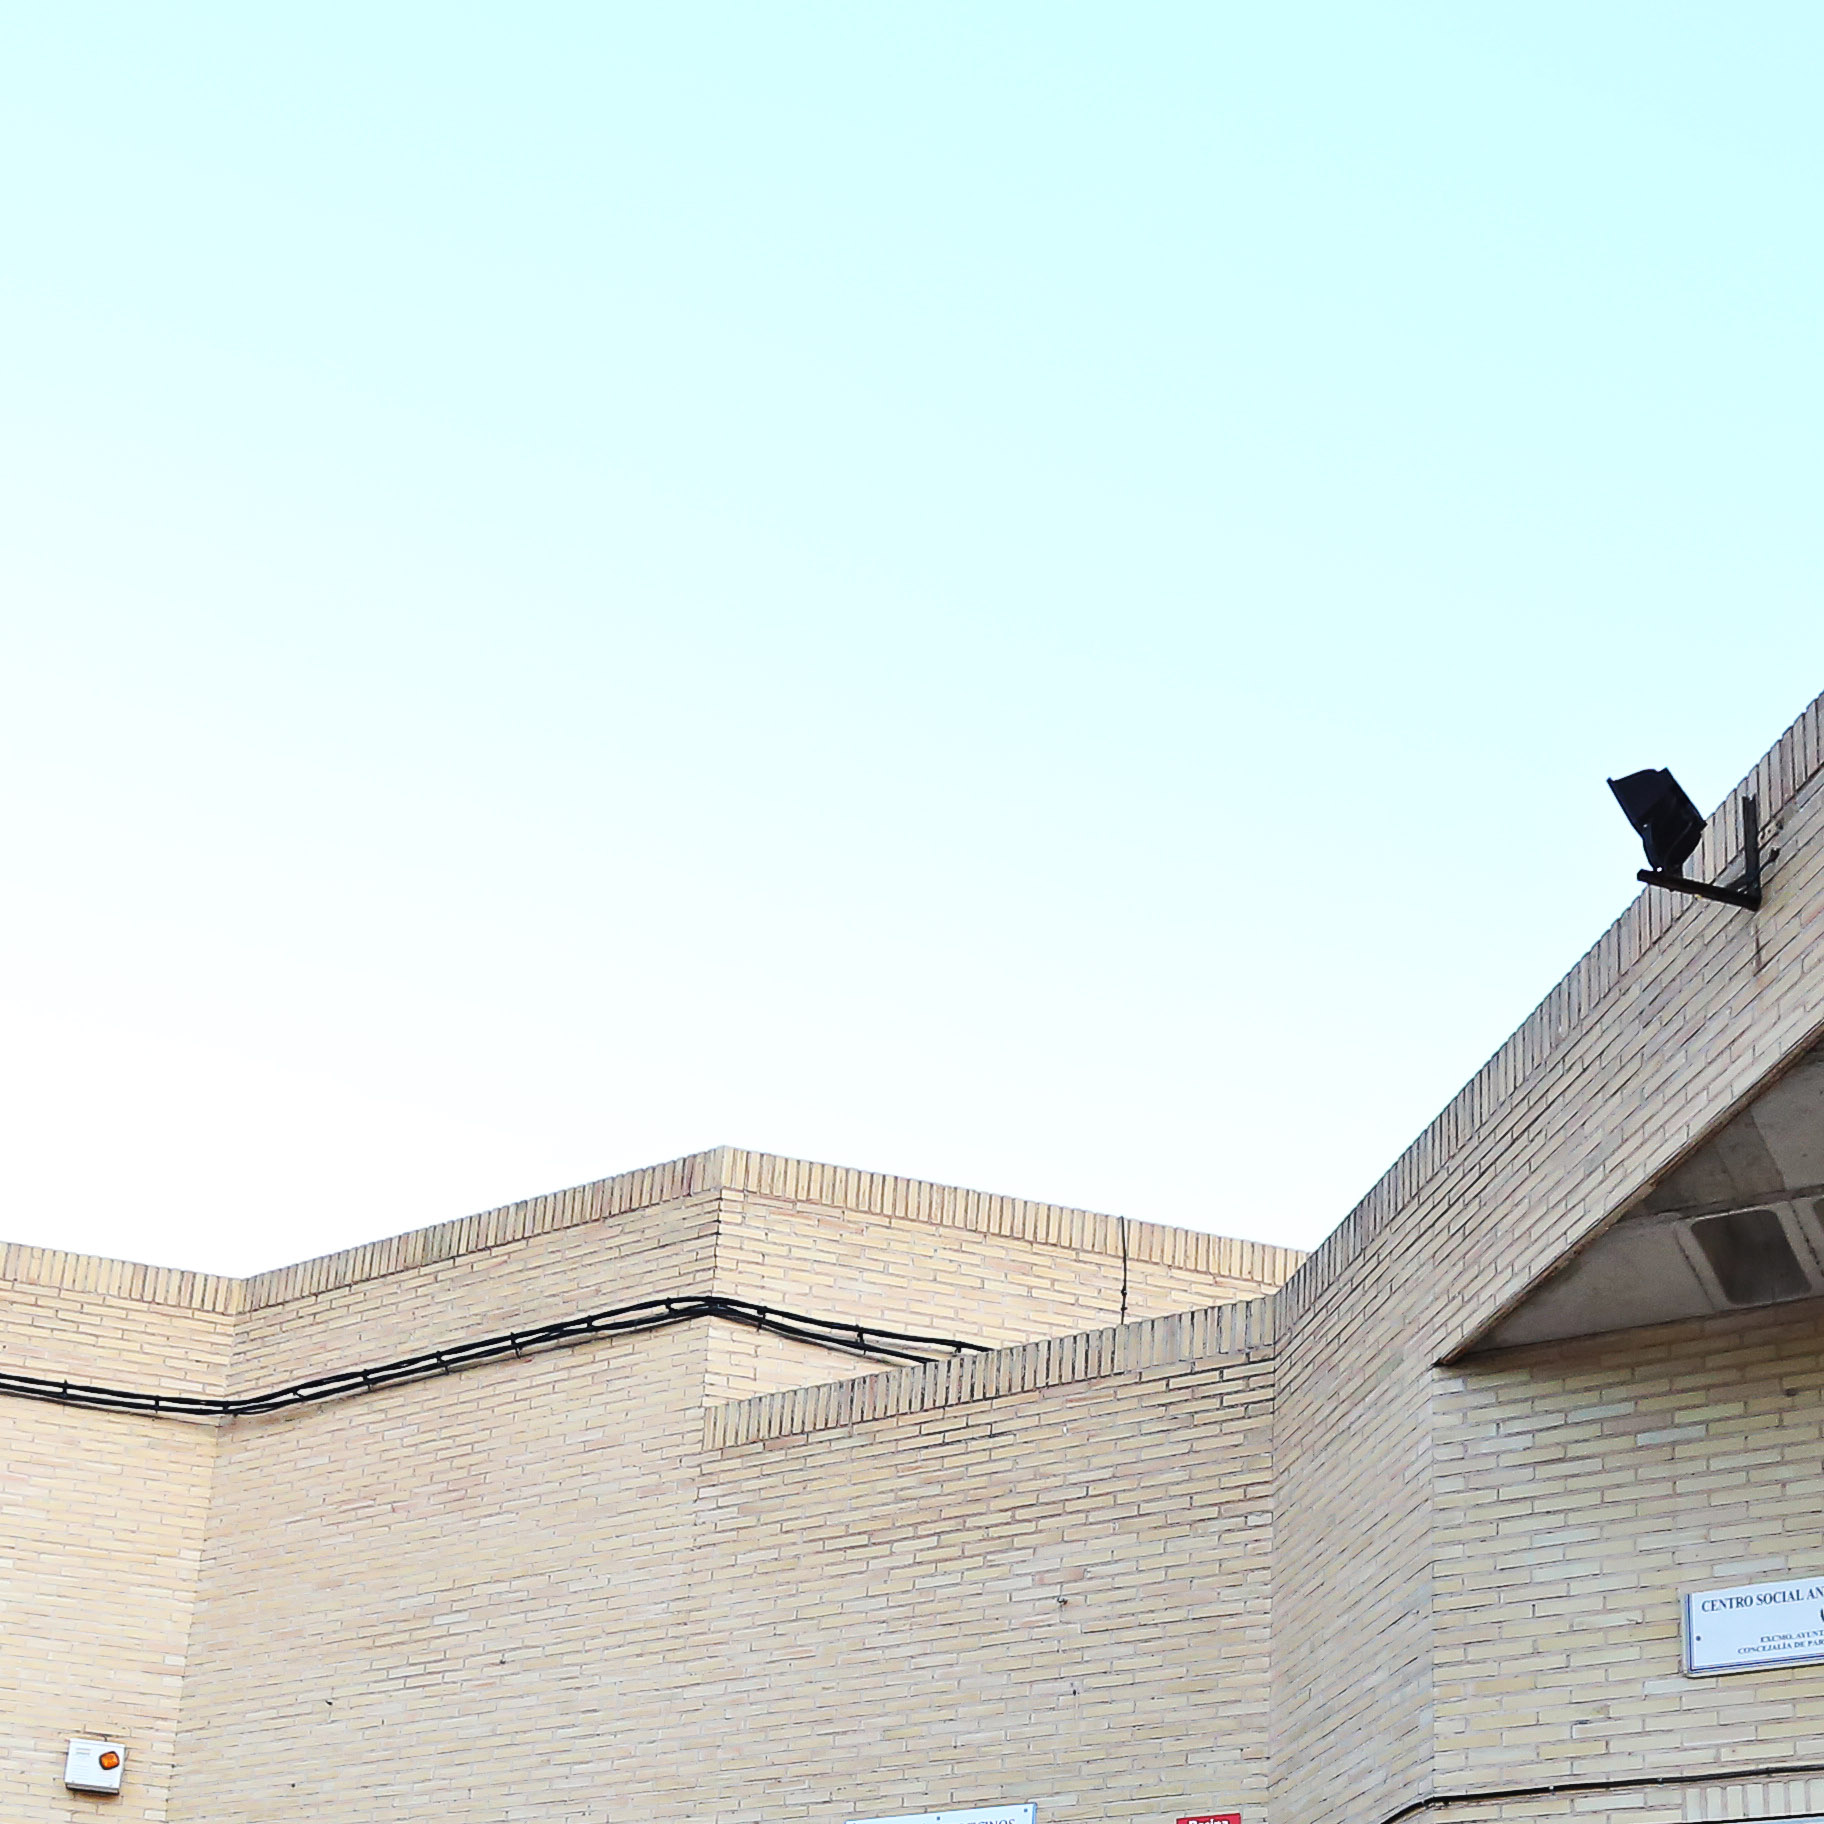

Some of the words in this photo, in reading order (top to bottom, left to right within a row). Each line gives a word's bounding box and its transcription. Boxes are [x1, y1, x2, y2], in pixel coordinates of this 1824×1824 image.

[1701, 1594, 1753, 1613] CENTRO
[1756, 1589, 1805, 1606] SOCIAL
[1794, 1640, 1806, 1648] DE
